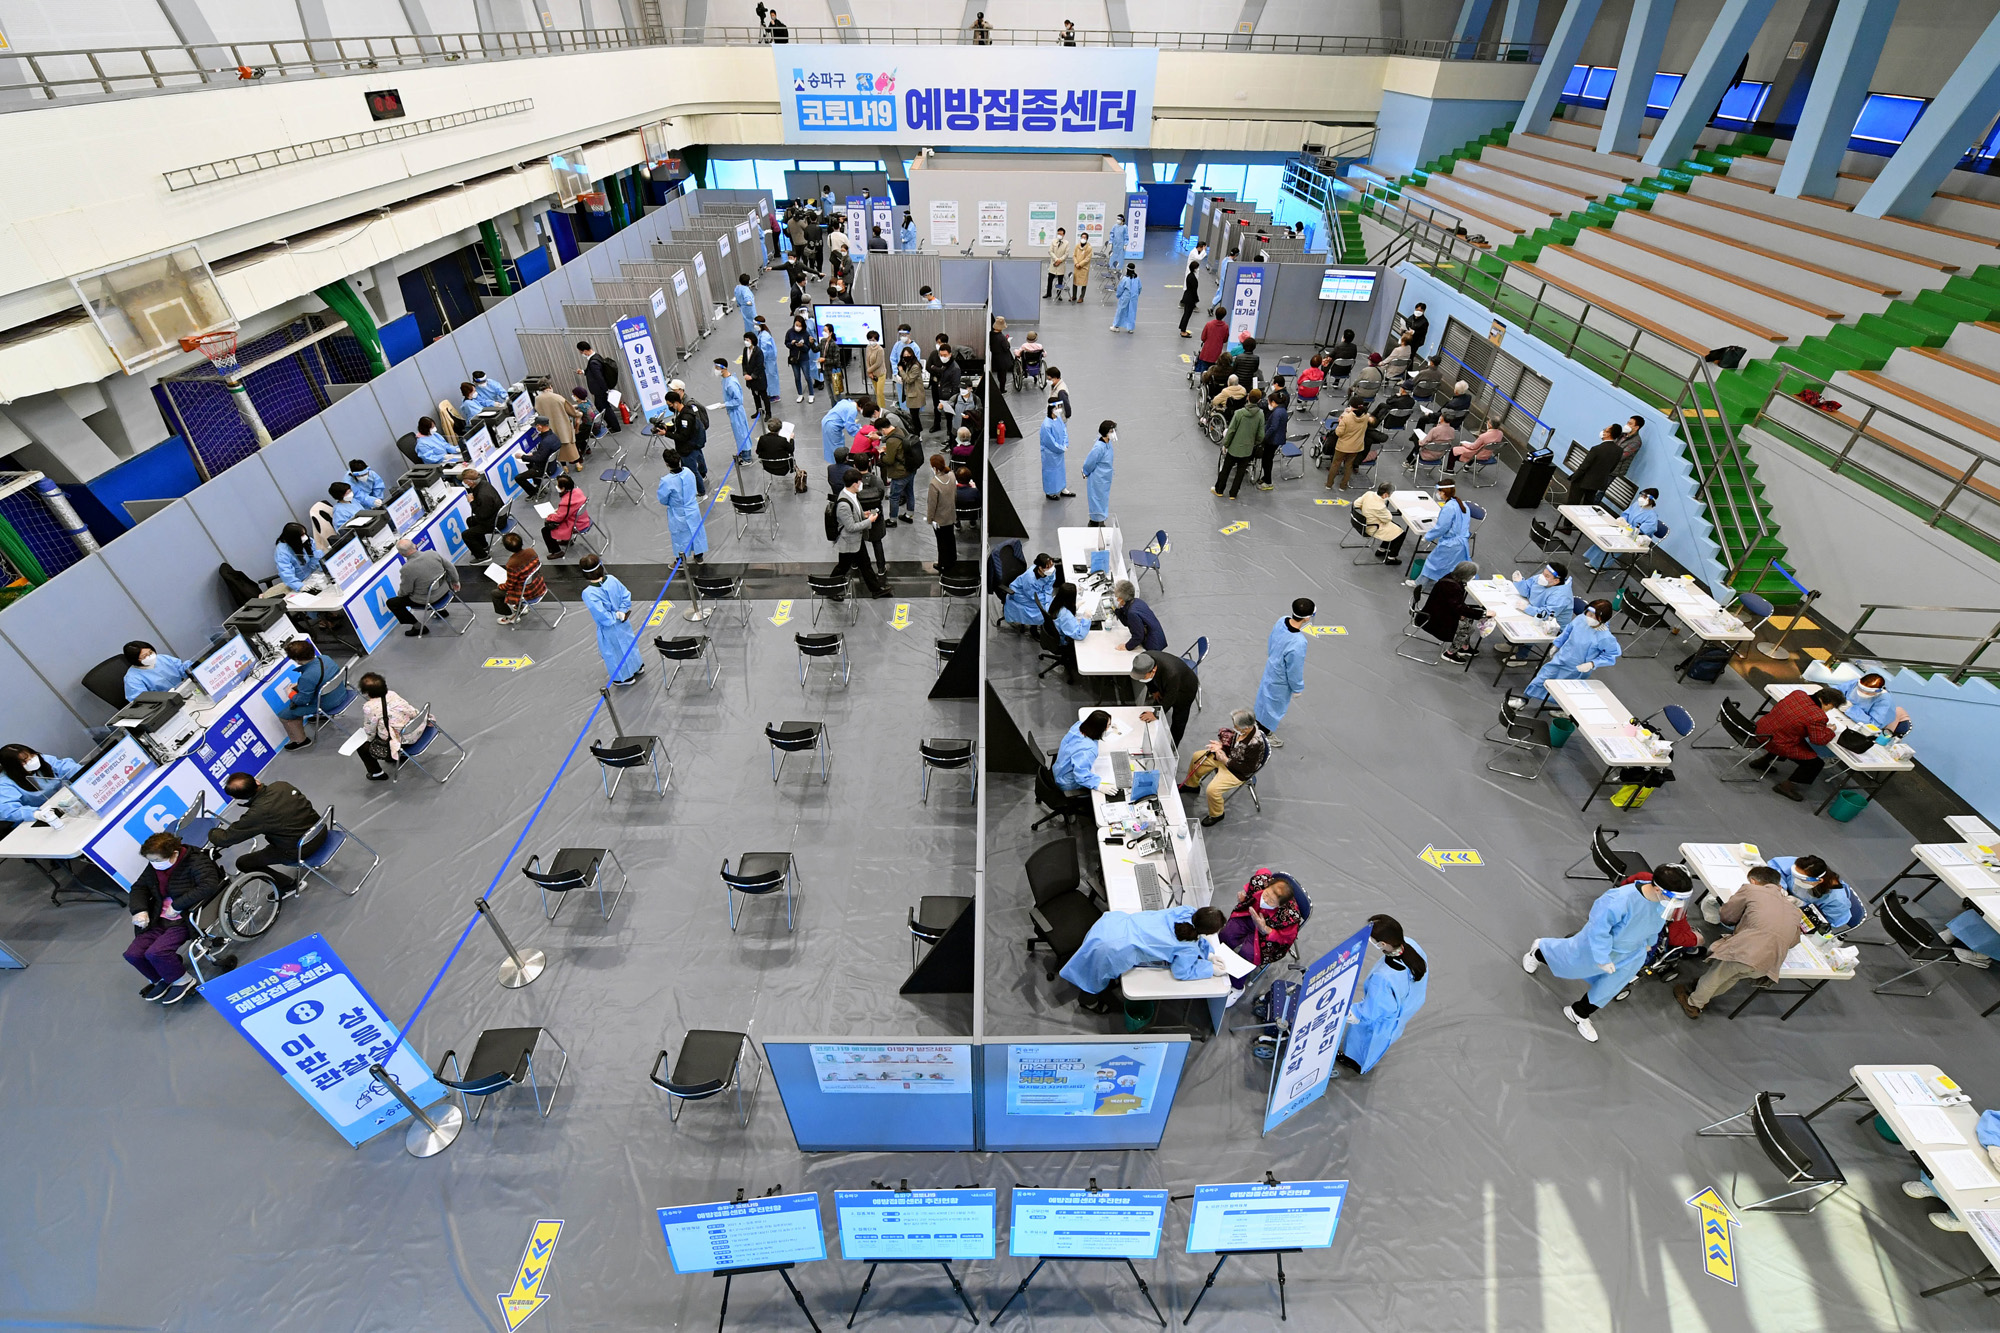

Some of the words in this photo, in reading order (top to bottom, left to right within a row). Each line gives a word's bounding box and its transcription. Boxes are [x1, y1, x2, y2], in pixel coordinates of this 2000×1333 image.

[807, 71, 847, 90] 송파구
[802, 100, 892, 128] 코로나19
[905, 88, 1136, 132] 예방접종센터
[1235, 308, 1256, 316] 대기실
[504, 462, 517, 488] 2
[447, 517, 462, 544] 3
[376, 585, 392, 616] 4
[208, 728, 258, 779] 접종내역
[143, 803, 178, 834] 6
[225, 975, 280, 1004] 코로나19
[235, 962, 333, 1014] 예방접종센터
[1306, 952, 1360, 996] 예방접종센터
[280, 1007, 367, 1056] 이상
[1290, 1020, 1339, 1060] 신원
[1295, 999, 1345, 1042] 접종자
[296, 1025, 381, 1073] 반응
[1286, 1035, 1334, 1076] 확인
